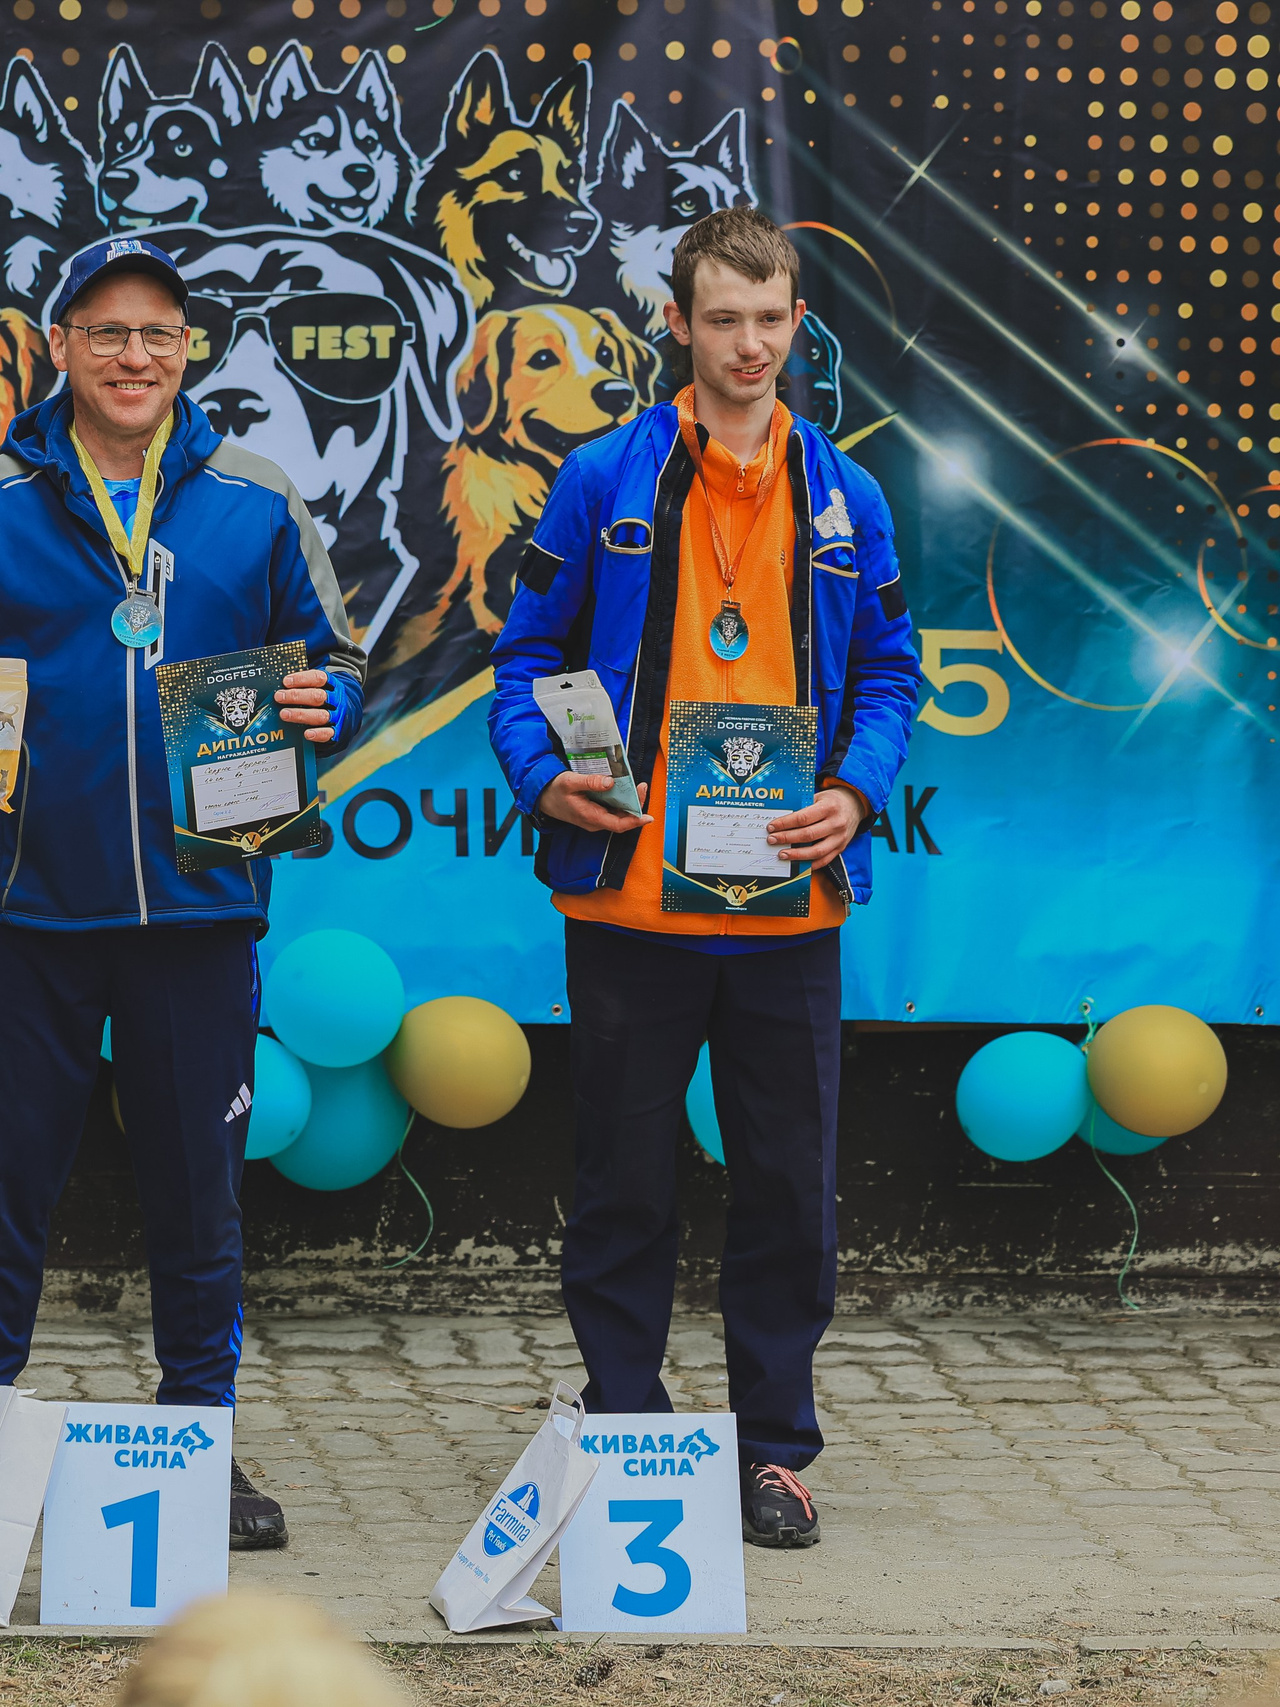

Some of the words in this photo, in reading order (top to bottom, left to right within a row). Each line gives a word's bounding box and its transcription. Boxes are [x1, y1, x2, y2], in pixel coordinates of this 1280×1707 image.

[292, 325, 396, 360] FEST
[207, 668, 263, 685] DOGFEST
[917, 629, 1010, 736] 5
[717, 721, 773, 731] DOGFEST
[196, 729, 284, 757] ДИПЛОМ
[696, 785, 784, 800] ДИПЛОМ
[245, 834, 256, 846] V
[731, 888, 743, 899] V
[64, 1422, 169, 1444] ЖИВАЯ
[114, 1449, 187, 1469] СИЛА
[623, 1458, 695, 1476] СИЛА
[490, 1498, 531, 1542] Farmina
[100, 1490, 160, 1608] 1
[608, 1500, 692, 1617] 3
